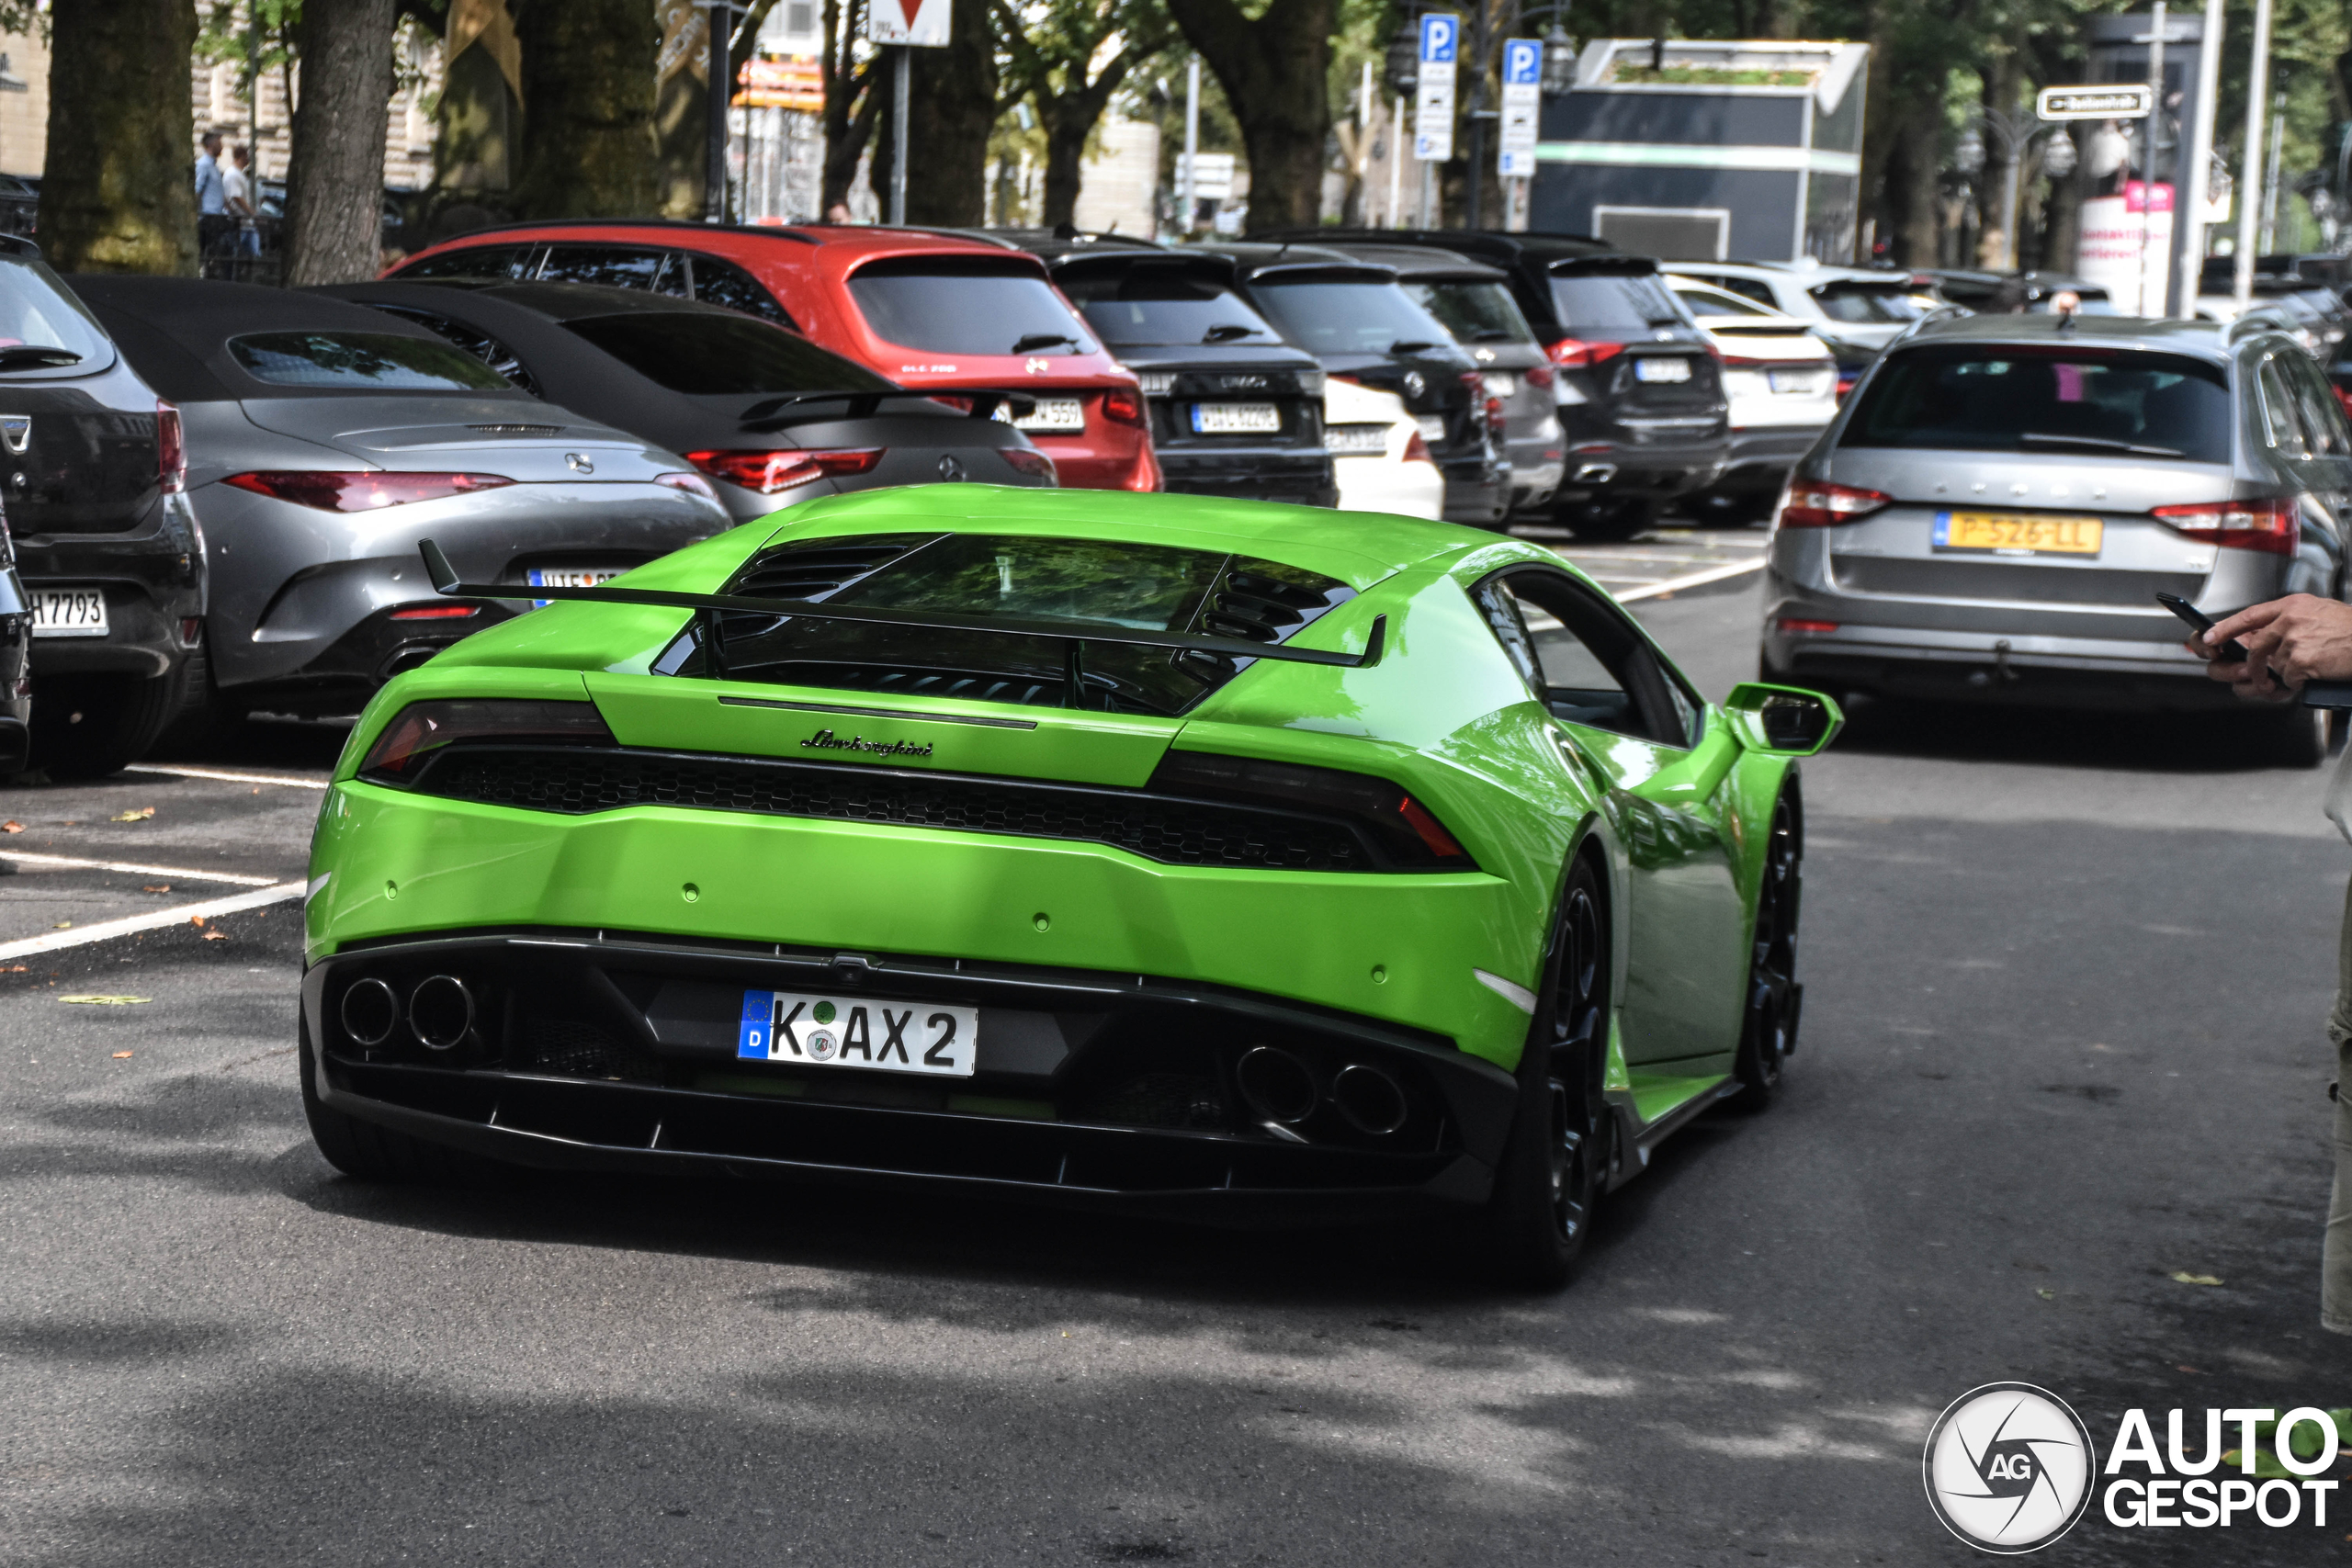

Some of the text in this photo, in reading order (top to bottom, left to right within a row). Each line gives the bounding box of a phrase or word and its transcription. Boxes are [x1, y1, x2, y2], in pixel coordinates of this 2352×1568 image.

[1427, 21, 1451, 61] P
[1510, 46, 1534, 83] P
[1051, 400, 1079, 423] 559
[1961, 516, 2088, 547] P-526-LL
[48, 593, 100, 624] 7793
[800, 728, 933, 757] Lamborghini
[749, 1031, 761, 1046] D
[771, 999, 807, 1056] K
[839, 1006, 913, 1064] AX
[923, 1012, 957, 1067] 2
